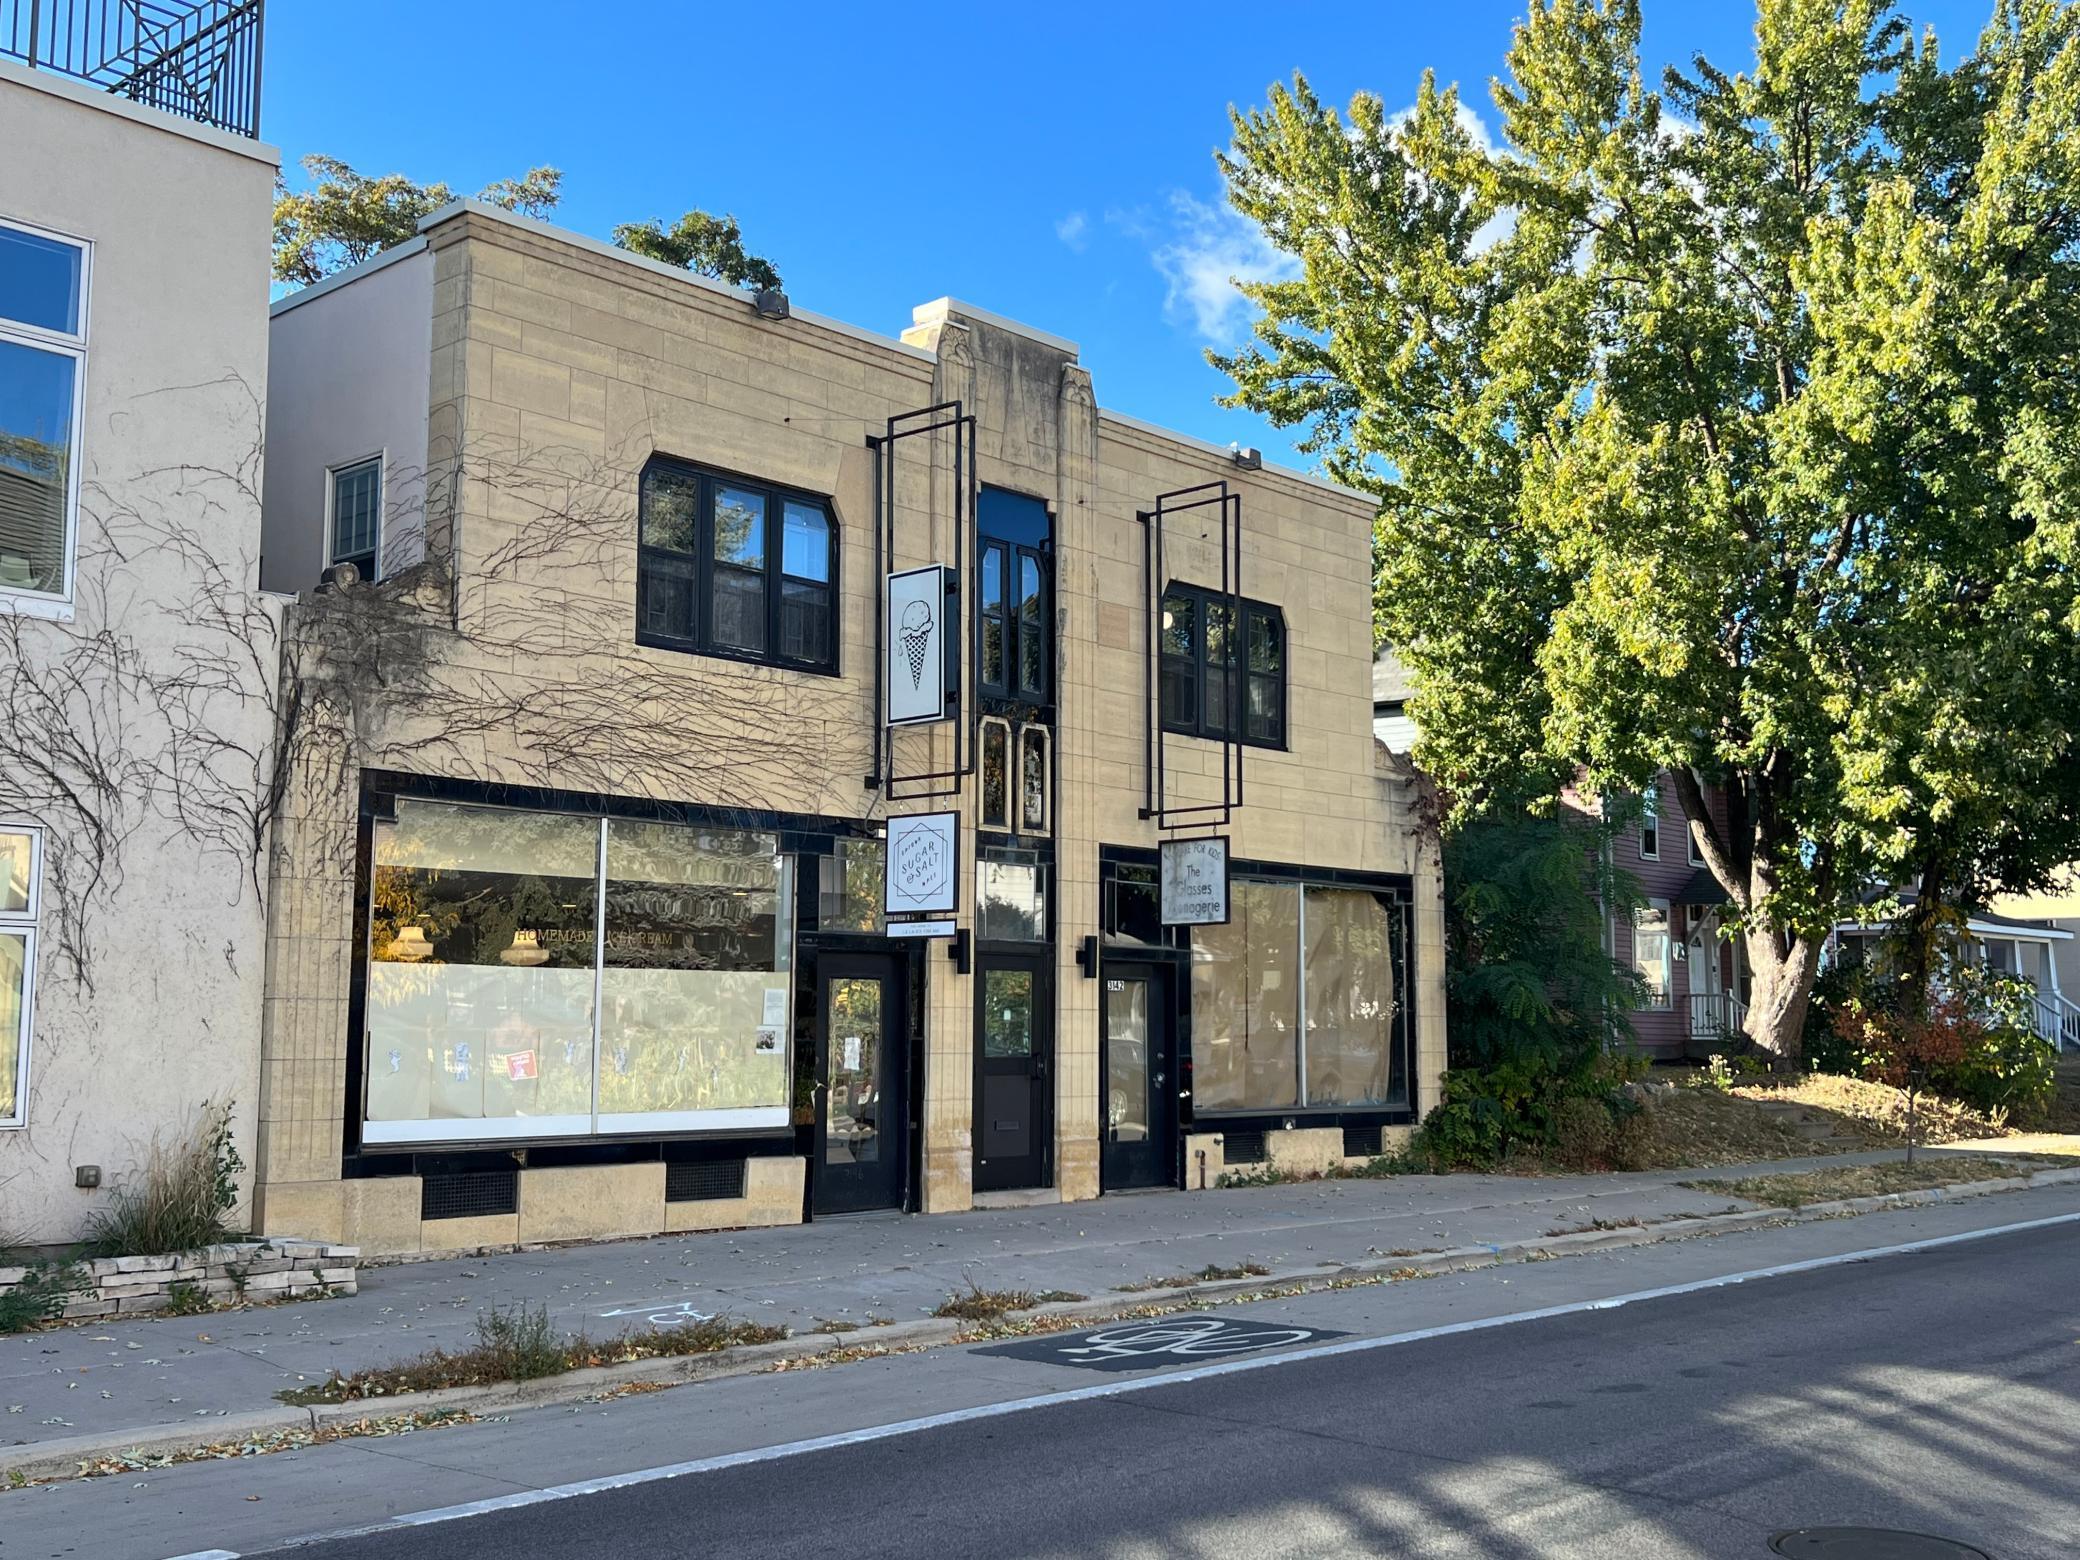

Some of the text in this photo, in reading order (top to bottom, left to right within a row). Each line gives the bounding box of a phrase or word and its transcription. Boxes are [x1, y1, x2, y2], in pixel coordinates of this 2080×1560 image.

[902, 841, 935, 874] SUGAR
[907, 852, 939, 884] & SALT
[1187, 865, 1200, 879] The
[517, 928, 595, 943] HOMEMADE
[632, 930, 673, 946] CREAM
